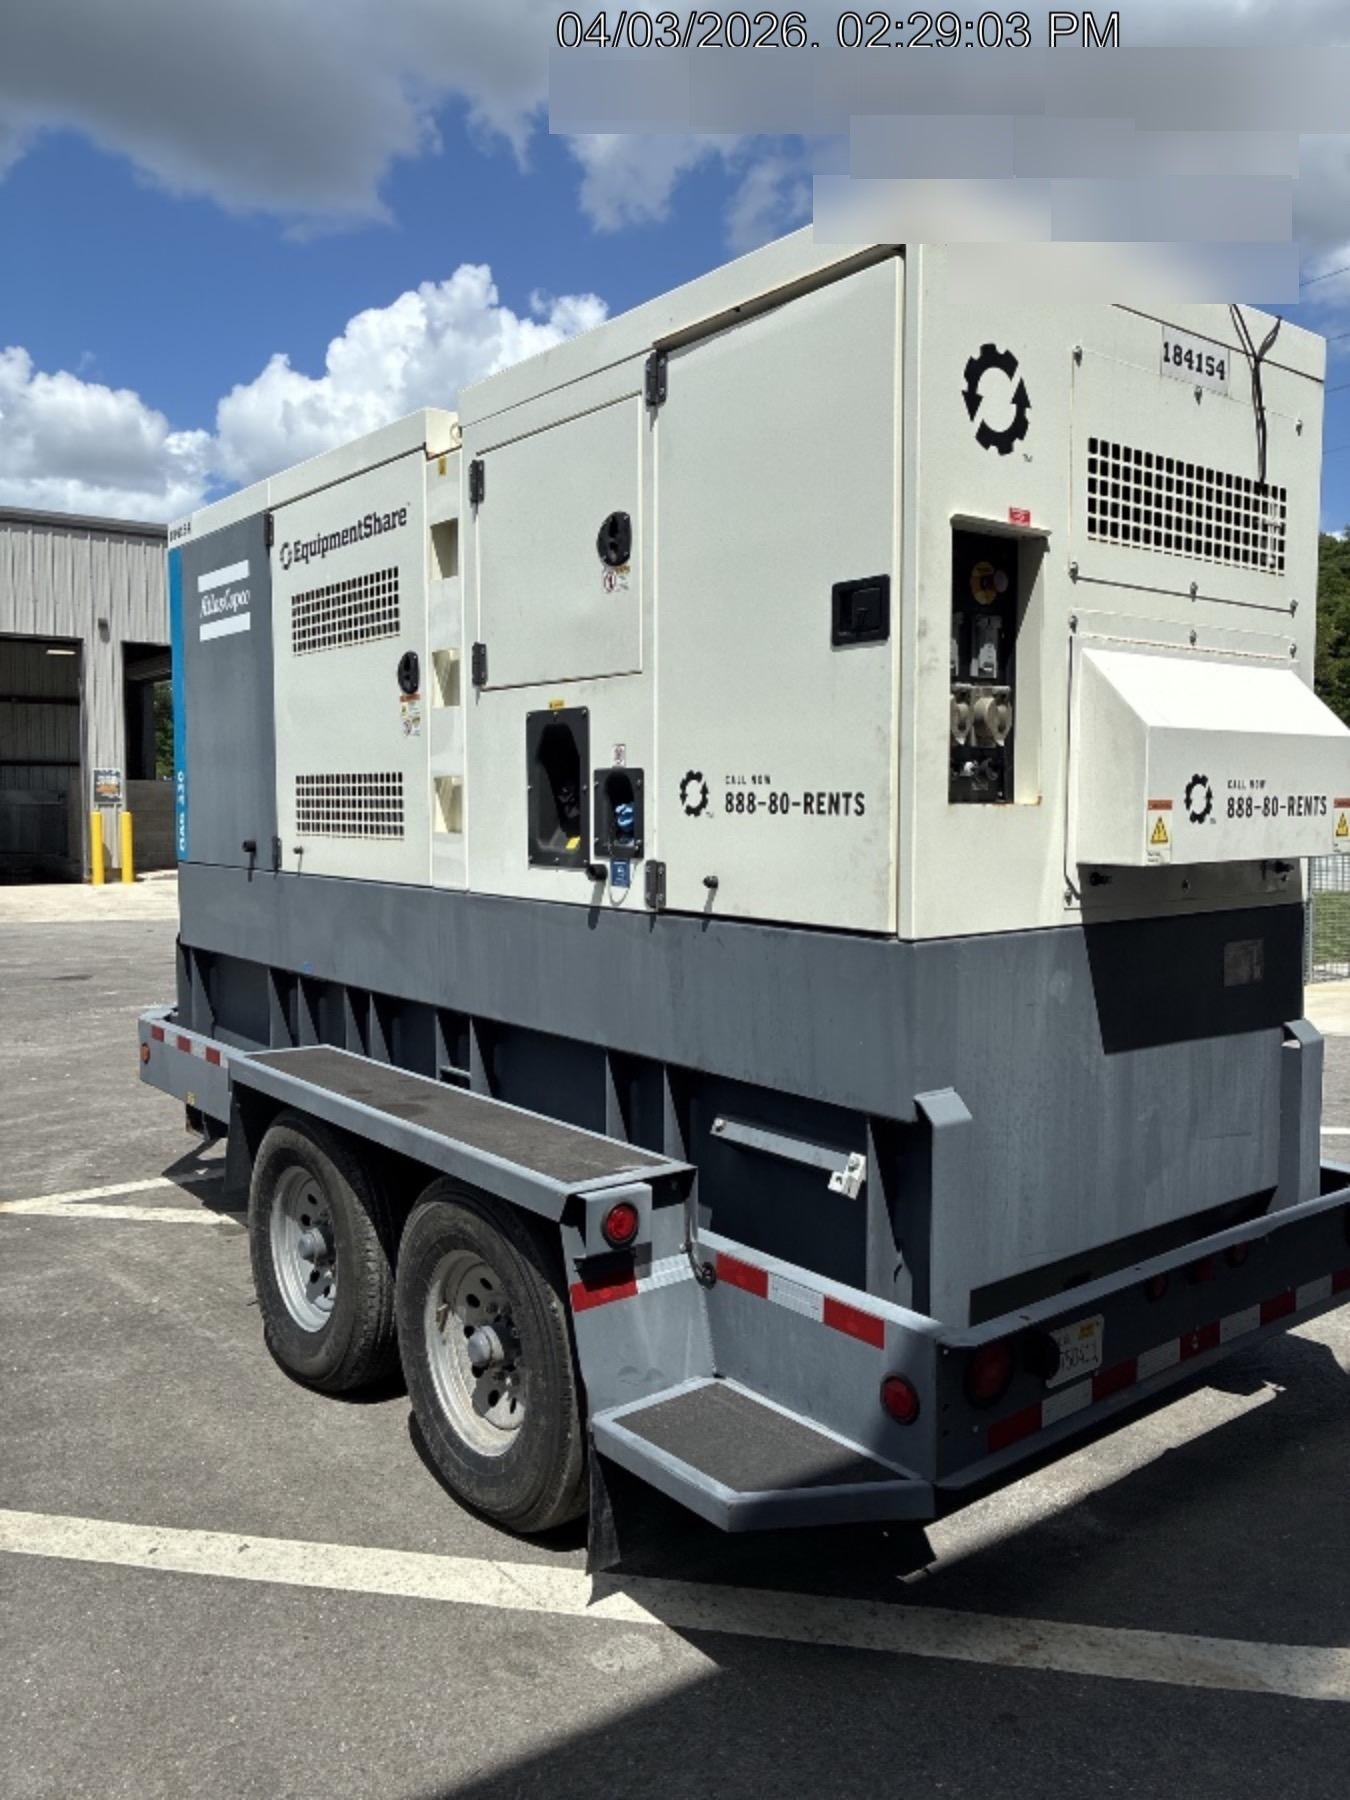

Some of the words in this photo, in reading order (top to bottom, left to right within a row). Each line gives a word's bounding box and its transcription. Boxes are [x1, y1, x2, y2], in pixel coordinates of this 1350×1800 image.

[1163, 340, 1226, 381] 184154
[293, 507, 408, 565] EquipmentShare
[725, 775, 747, 785] CALL
[751, 775, 771, 786] NOW
[1227, 779, 1246, 790] CALL
[1249, 779, 1266, 789] NOW
[724, 791, 866, 816] 888-80-RENTS
[1227, 795, 1327, 818] 888-80-RENTS
